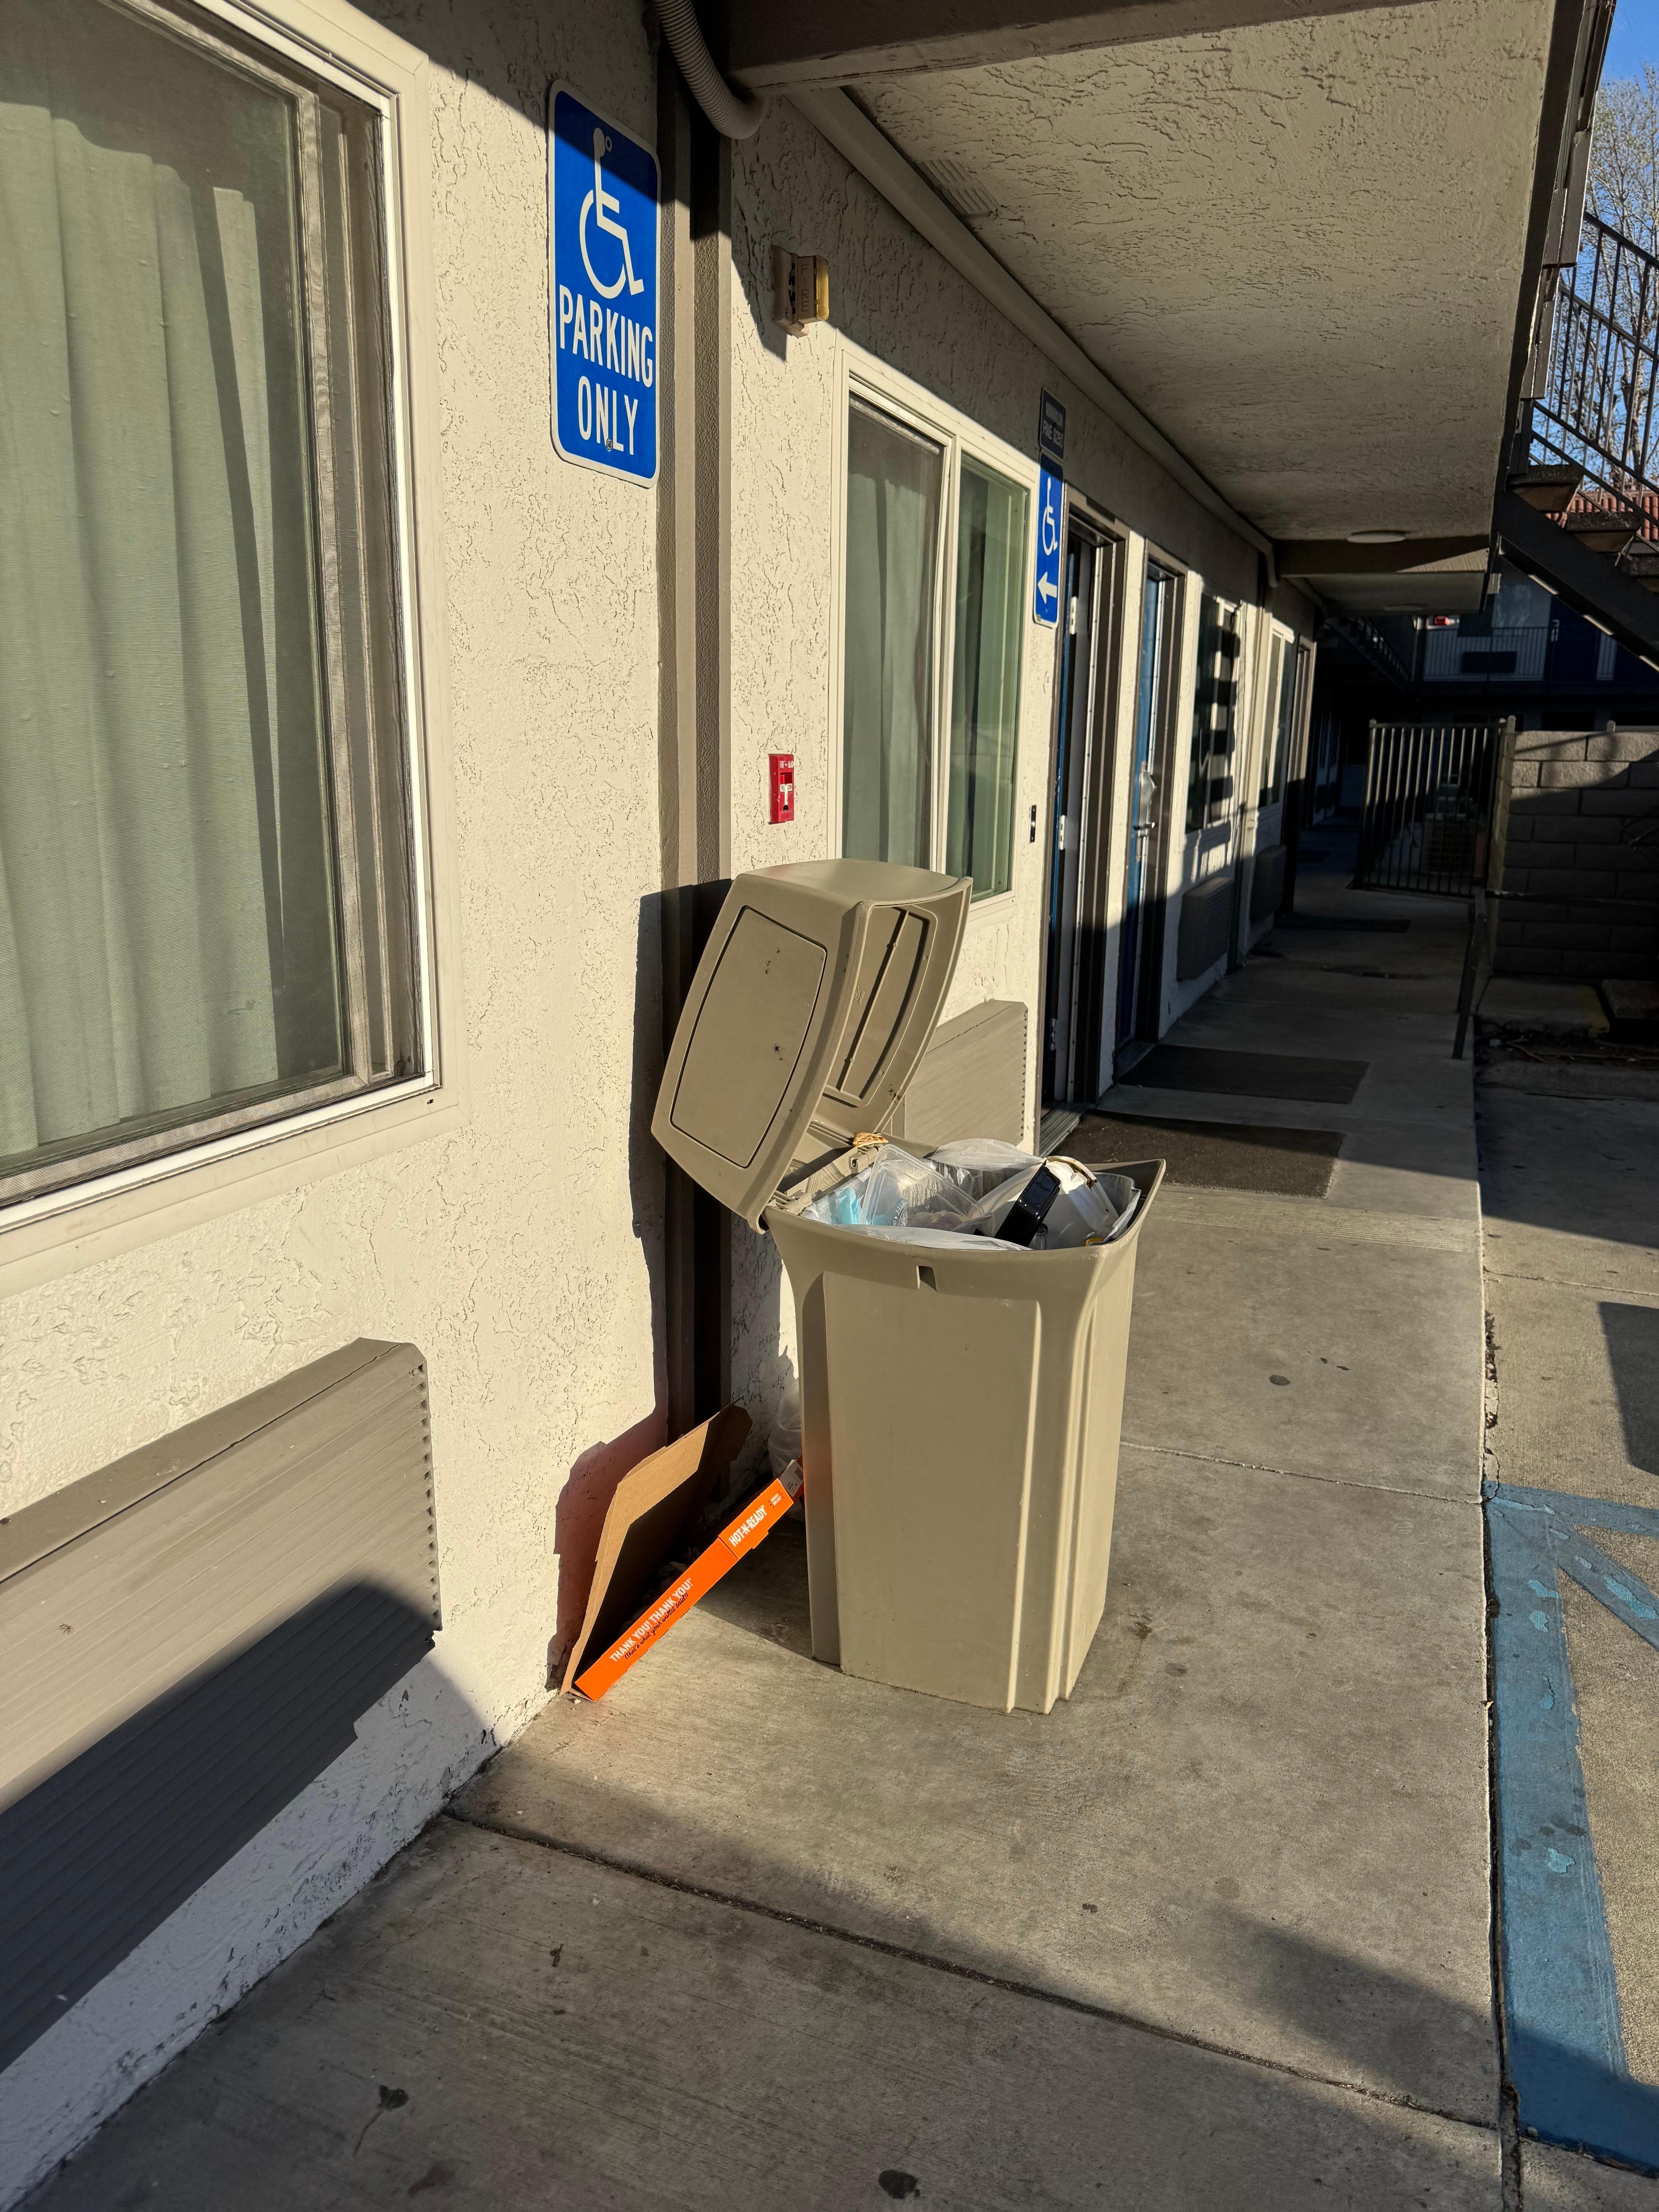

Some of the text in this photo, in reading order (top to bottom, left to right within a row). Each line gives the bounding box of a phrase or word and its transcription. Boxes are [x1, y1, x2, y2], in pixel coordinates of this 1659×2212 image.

[801, 264, 809, 312] FIRE
[560, 285, 653, 387] PARKING
[579, 376, 638, 455] ONLY
[610, 1637, 637, 1662] THANK
[632, 1620, 653, 1639] YOU!
[649, 1597, 677, 1623] THANK
[640, 1632, 651, 1644] what
